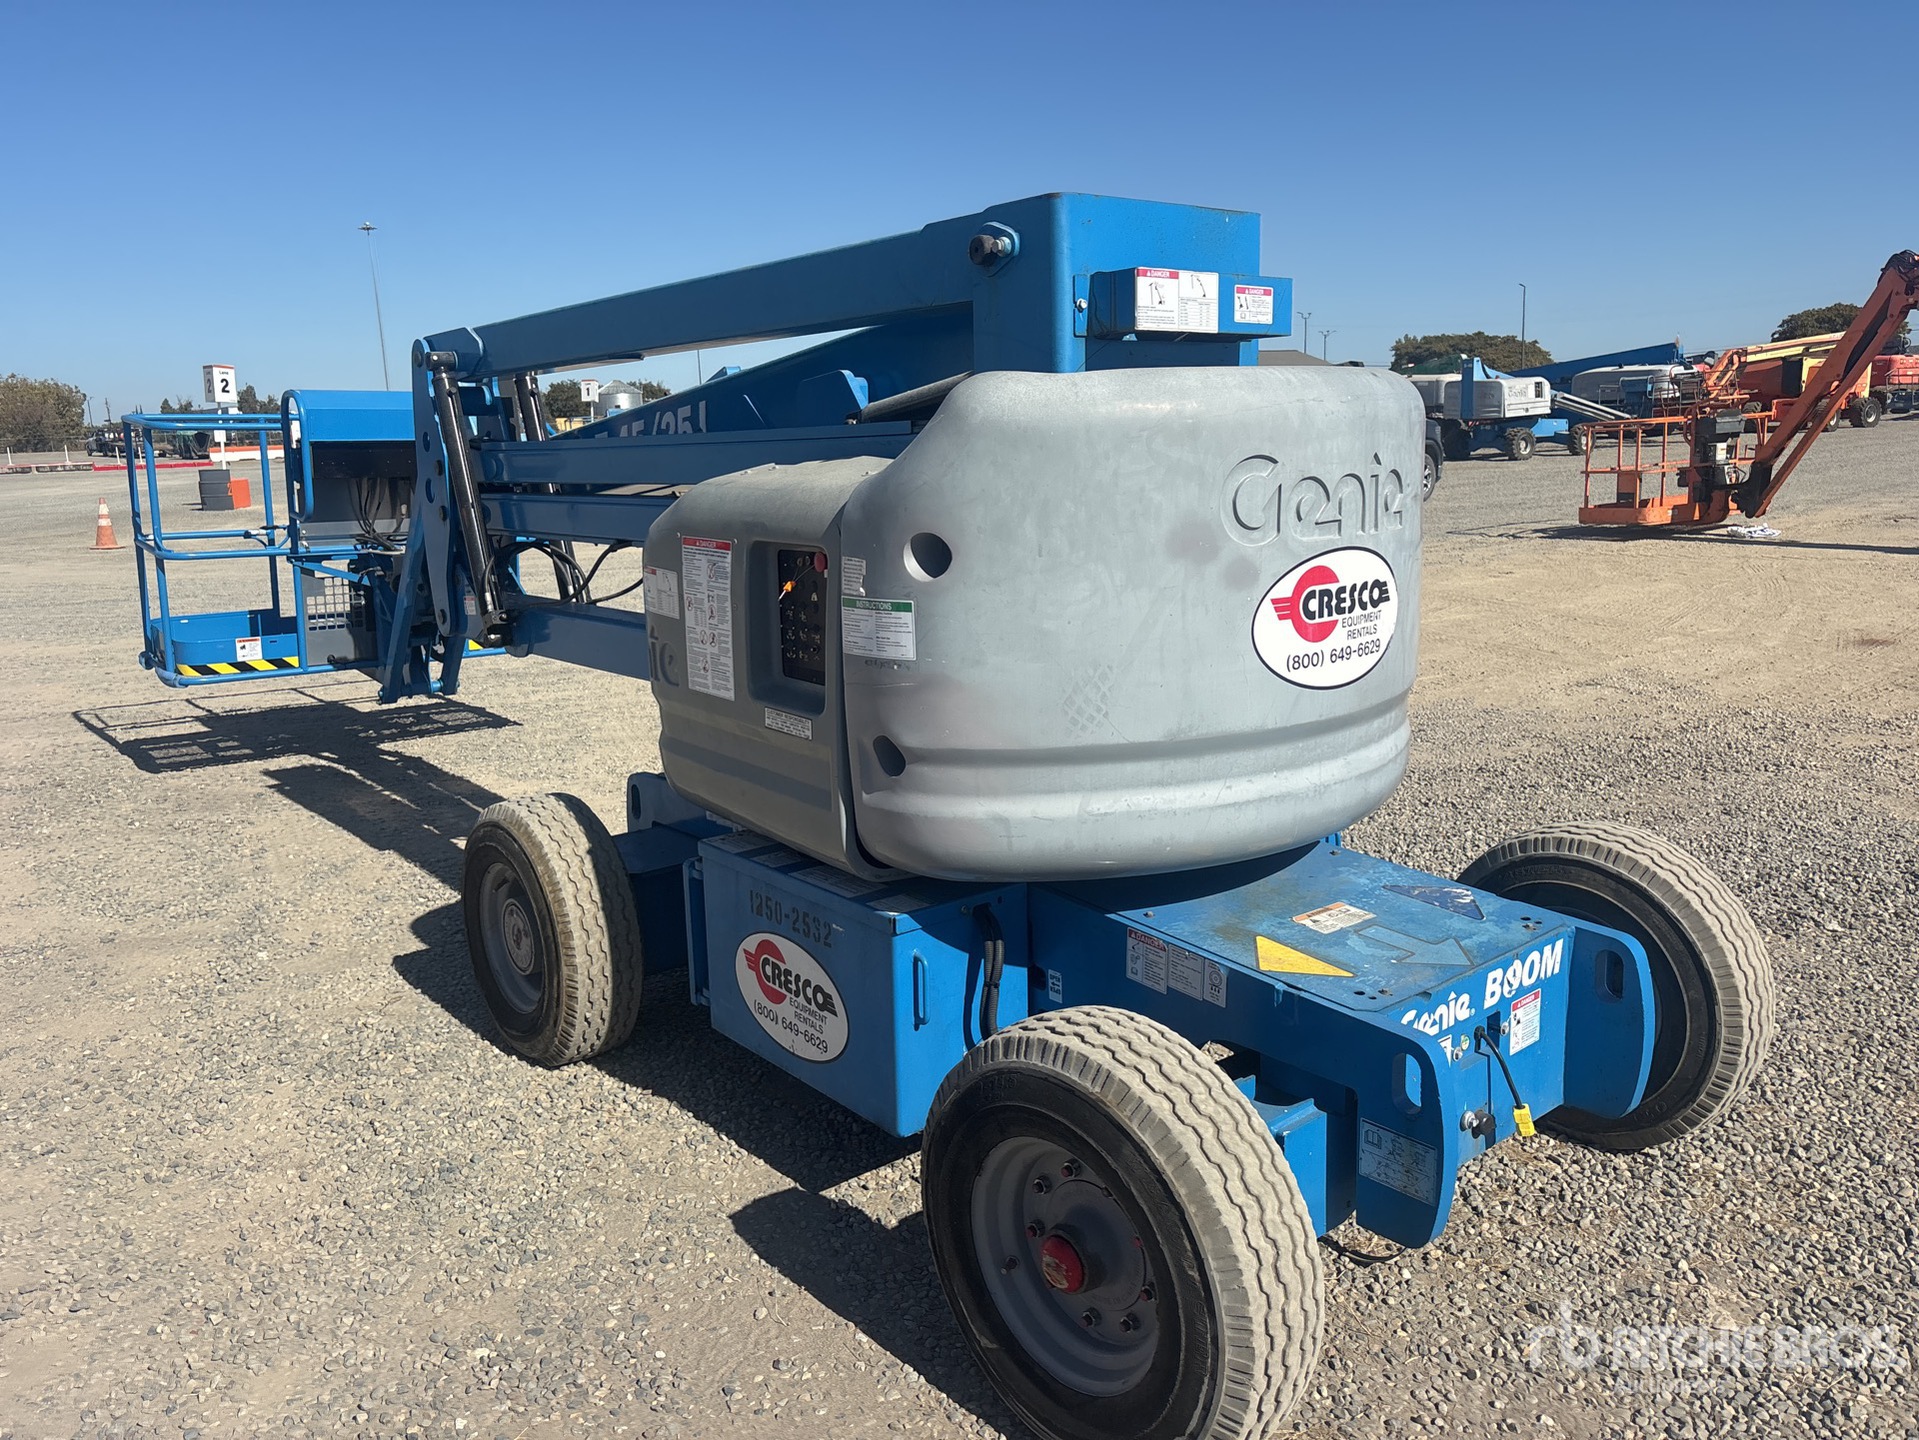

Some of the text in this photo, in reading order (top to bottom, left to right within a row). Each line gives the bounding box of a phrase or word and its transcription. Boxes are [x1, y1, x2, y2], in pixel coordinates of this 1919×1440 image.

[1150, 270, 1170, 279] DANGER
[207, 379, 212, 393] 2
[220, 378, 230, 393] 2
[586, 387, 590, 396] 1
[1219, 452, 1404, 547] Genie
[855, 600, 893, 611] INSTRUCTIONS
[1302, 579, 1390, 621] CRESCO
[1341, 610, 1382, 629] EQUIPMENT
[1346, 623, 1378, 641] RENTALS
[1286, 638, 1381, 673] (800) 649-6629
[1136, 932, 1166, 953] DANGER
[1483, 938, 1564, 1010] BOOM
[761, 956, 838, 1018] CRESCO
[789, 996, 828, 1026] EQUIPMENT
[753, 999, 829, 1054] (800) 649-6629
[794, 1012, 824, 1035] RENTALS
